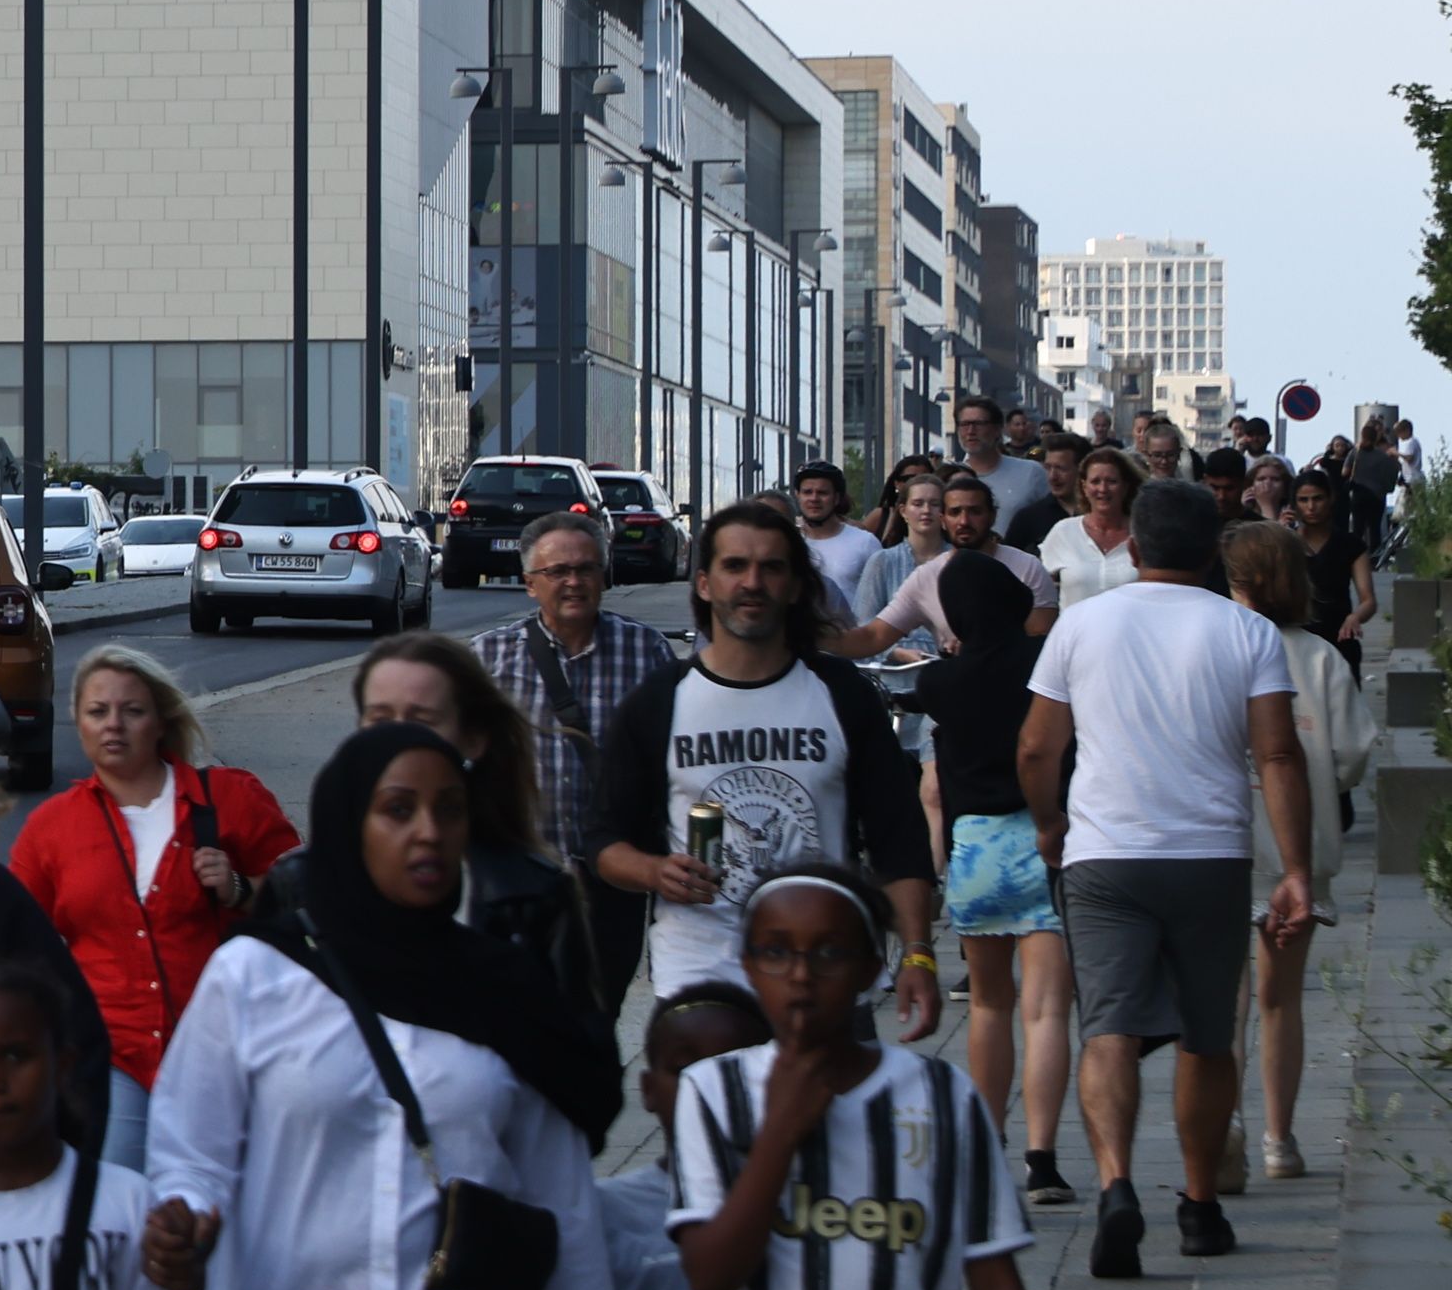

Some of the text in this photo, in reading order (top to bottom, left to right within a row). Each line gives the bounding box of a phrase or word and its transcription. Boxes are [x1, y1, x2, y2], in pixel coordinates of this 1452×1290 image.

[674, 727, 827, 768] RAMONES
[709, 770, 794, 800] JOHNNY
[772, 1182, 926, 1253] Jeep
